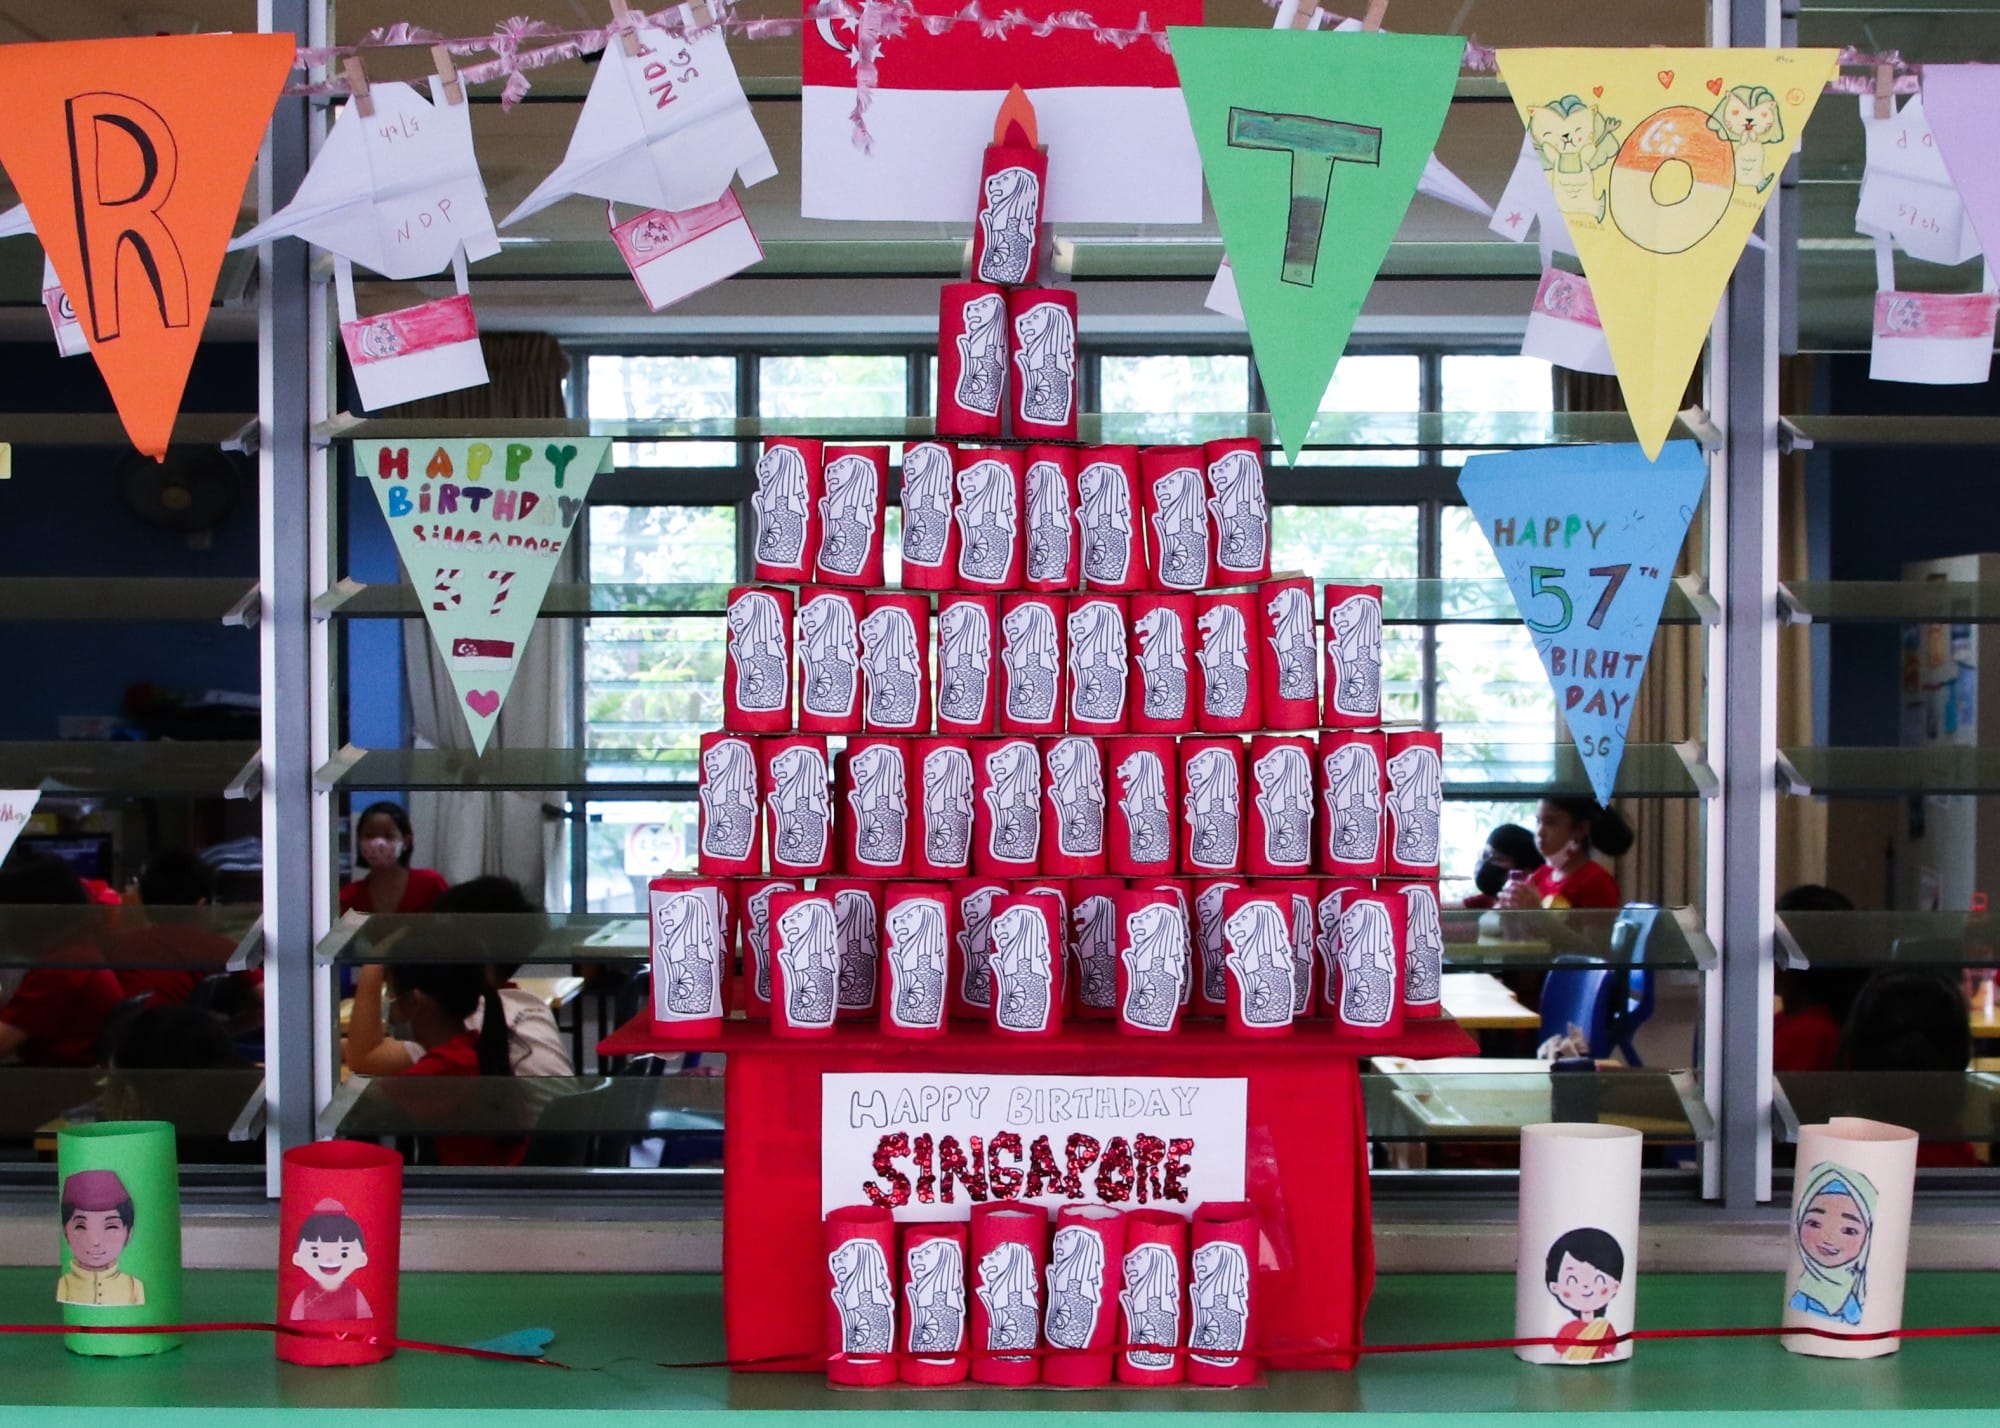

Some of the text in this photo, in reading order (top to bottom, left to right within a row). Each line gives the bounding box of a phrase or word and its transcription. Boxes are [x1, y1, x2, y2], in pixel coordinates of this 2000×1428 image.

[636, 43, 678, 109] NDP
[65, 91, 190, 343] R
[1227, 106, 1383, 288] T
[397, 198, 451, 243] NDP
[378, 443, 578, 488] HAPPY
[1494, 514, 1607, 549] HAPPY
[432, 567, 518, 616] 57
[1551, 646, 1643, 679] BIRHT
[1565, 685, 1630, 719] DAY
[1582, 735, 1611, 758] SG
[850, 1085, 1200, 1129] HAPPY BIRTHDAY
[863, 1130, 1194, 1209] SINGAPORE
